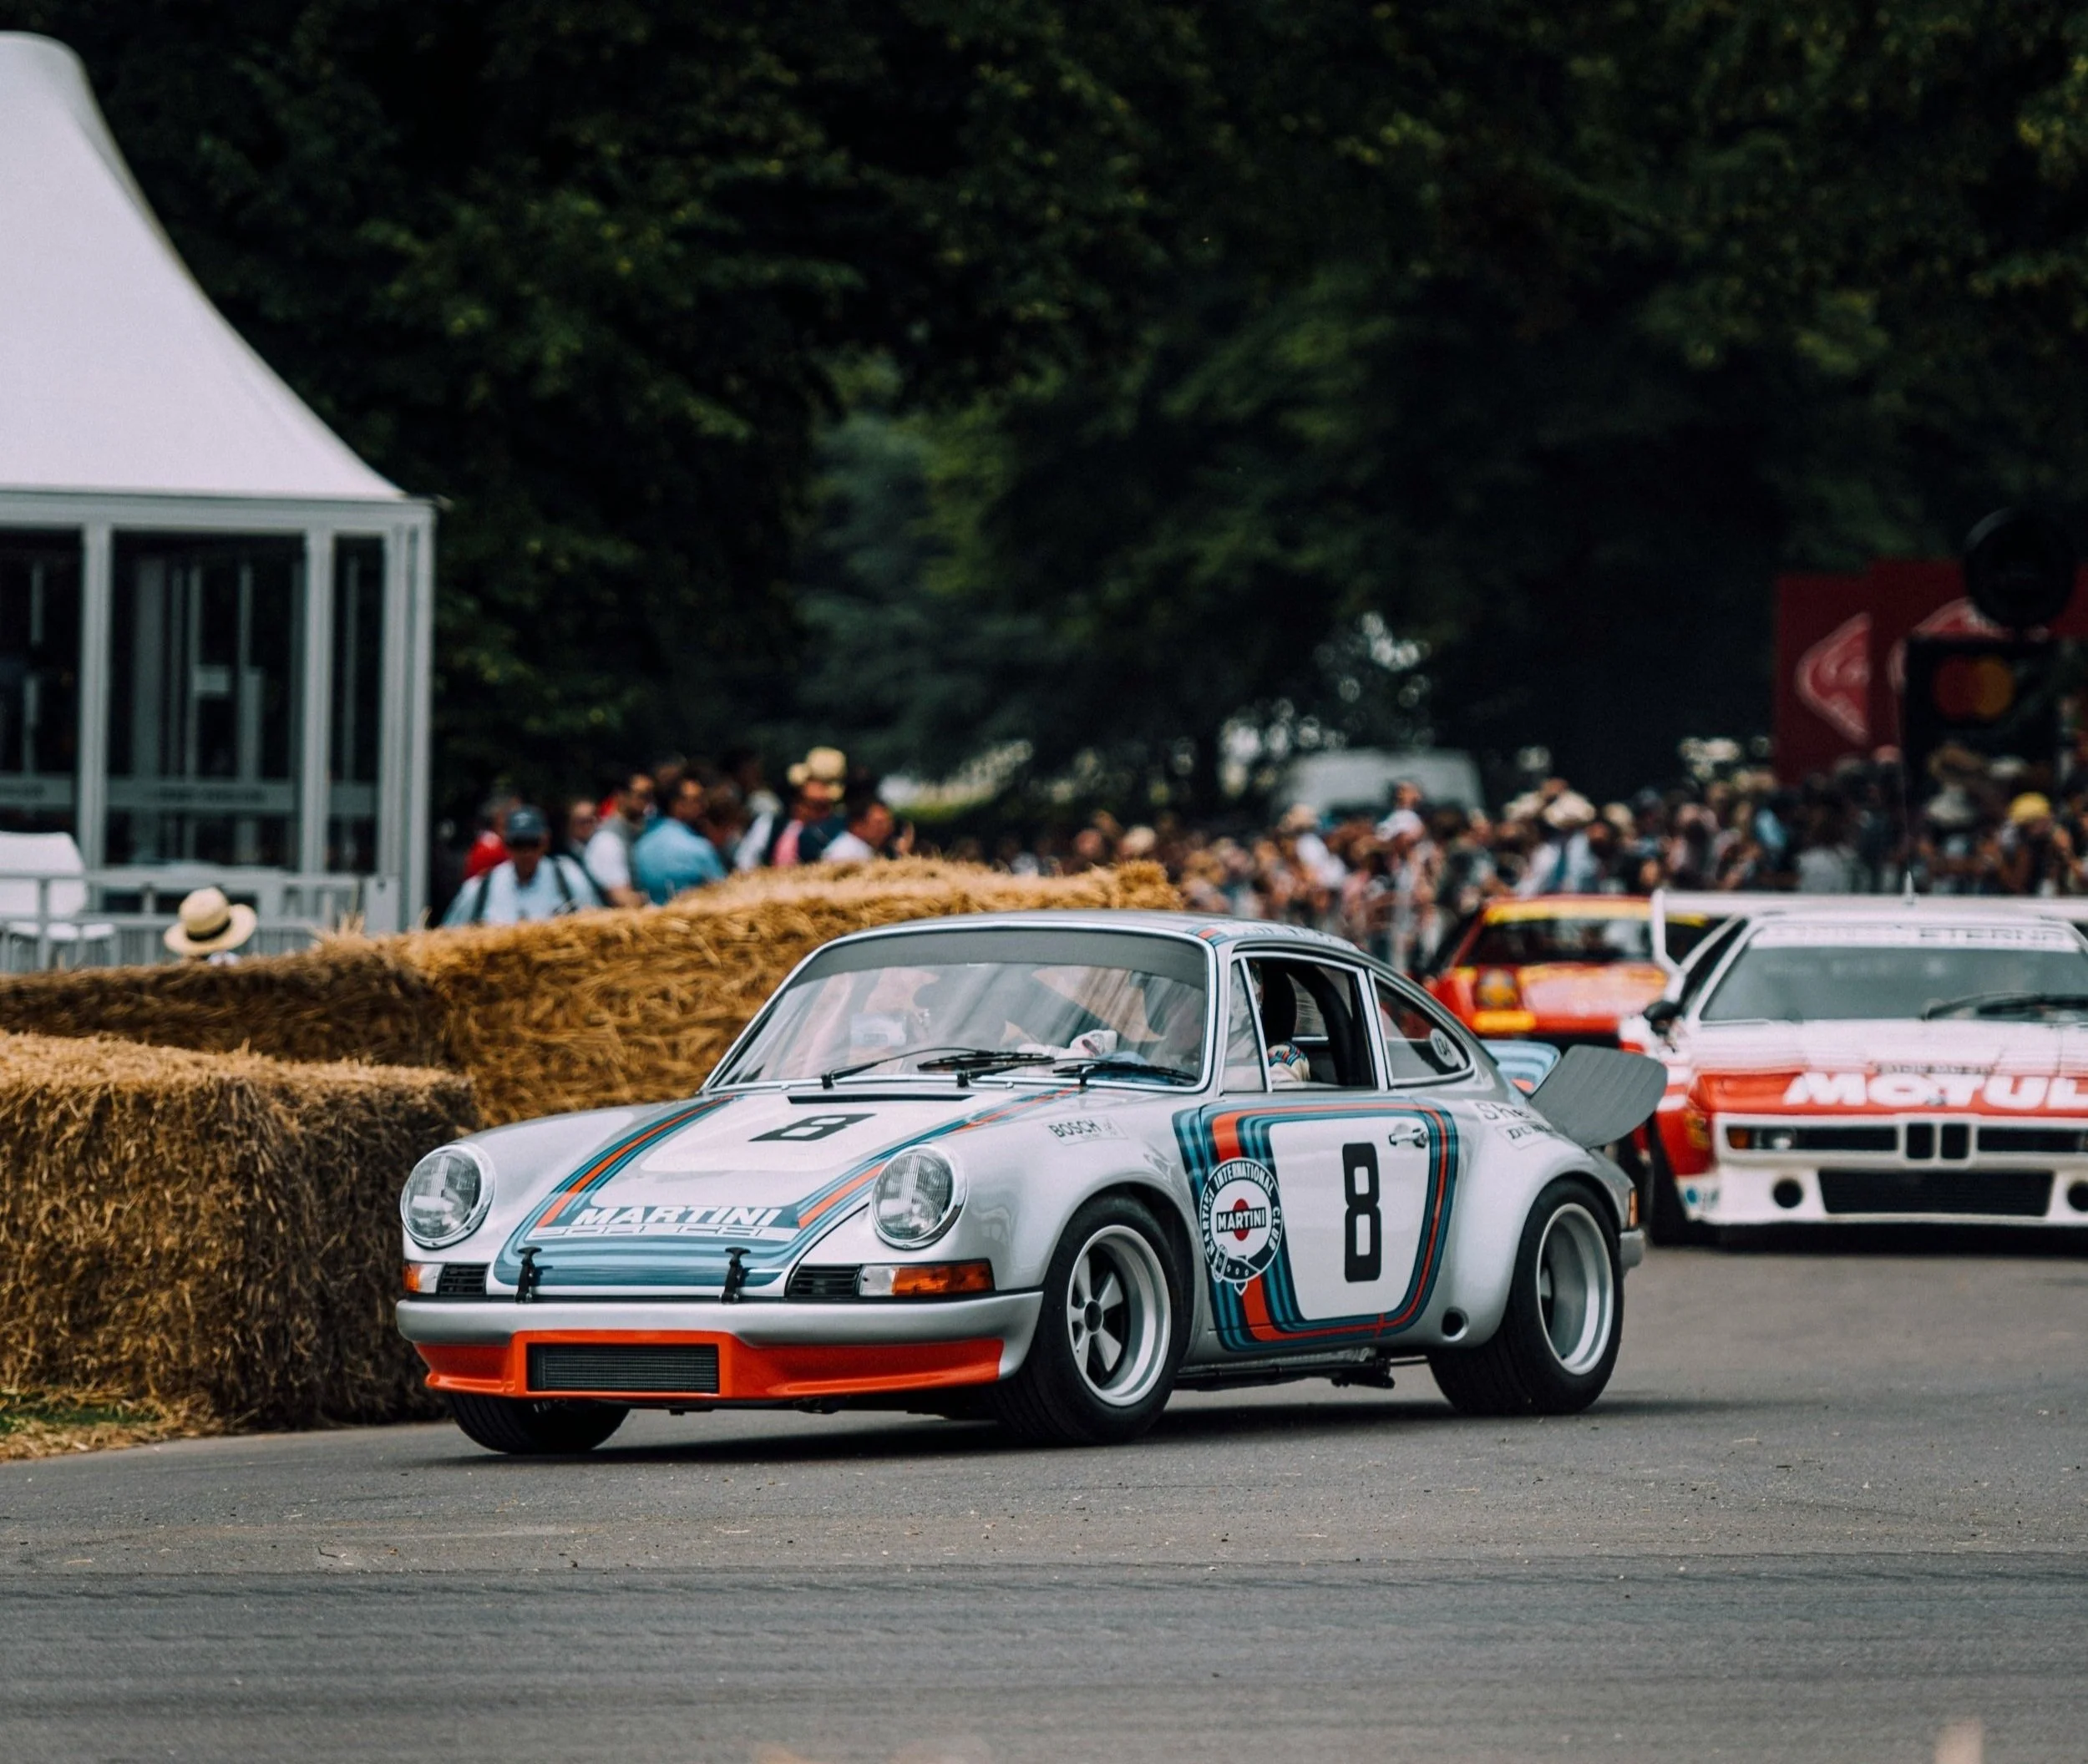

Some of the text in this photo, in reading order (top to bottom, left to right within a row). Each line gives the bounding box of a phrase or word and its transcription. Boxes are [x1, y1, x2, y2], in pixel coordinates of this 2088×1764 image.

[1781, 1070, 2088, 1110] MOTUL
[748, 1113, 878, 1143] 8
[1048, 1118, 1103, 1138] BOSCH
[570, 1204, 783, 1227] MARTINI
[1214, 1161, 1275, 1198] INTERNATIONAL
[1268, 1205, 1282, 1252] CLUB
[1217, 1209, 1266, 1232] MARTINI
[1341, 1141, 1382, 1284] 8
